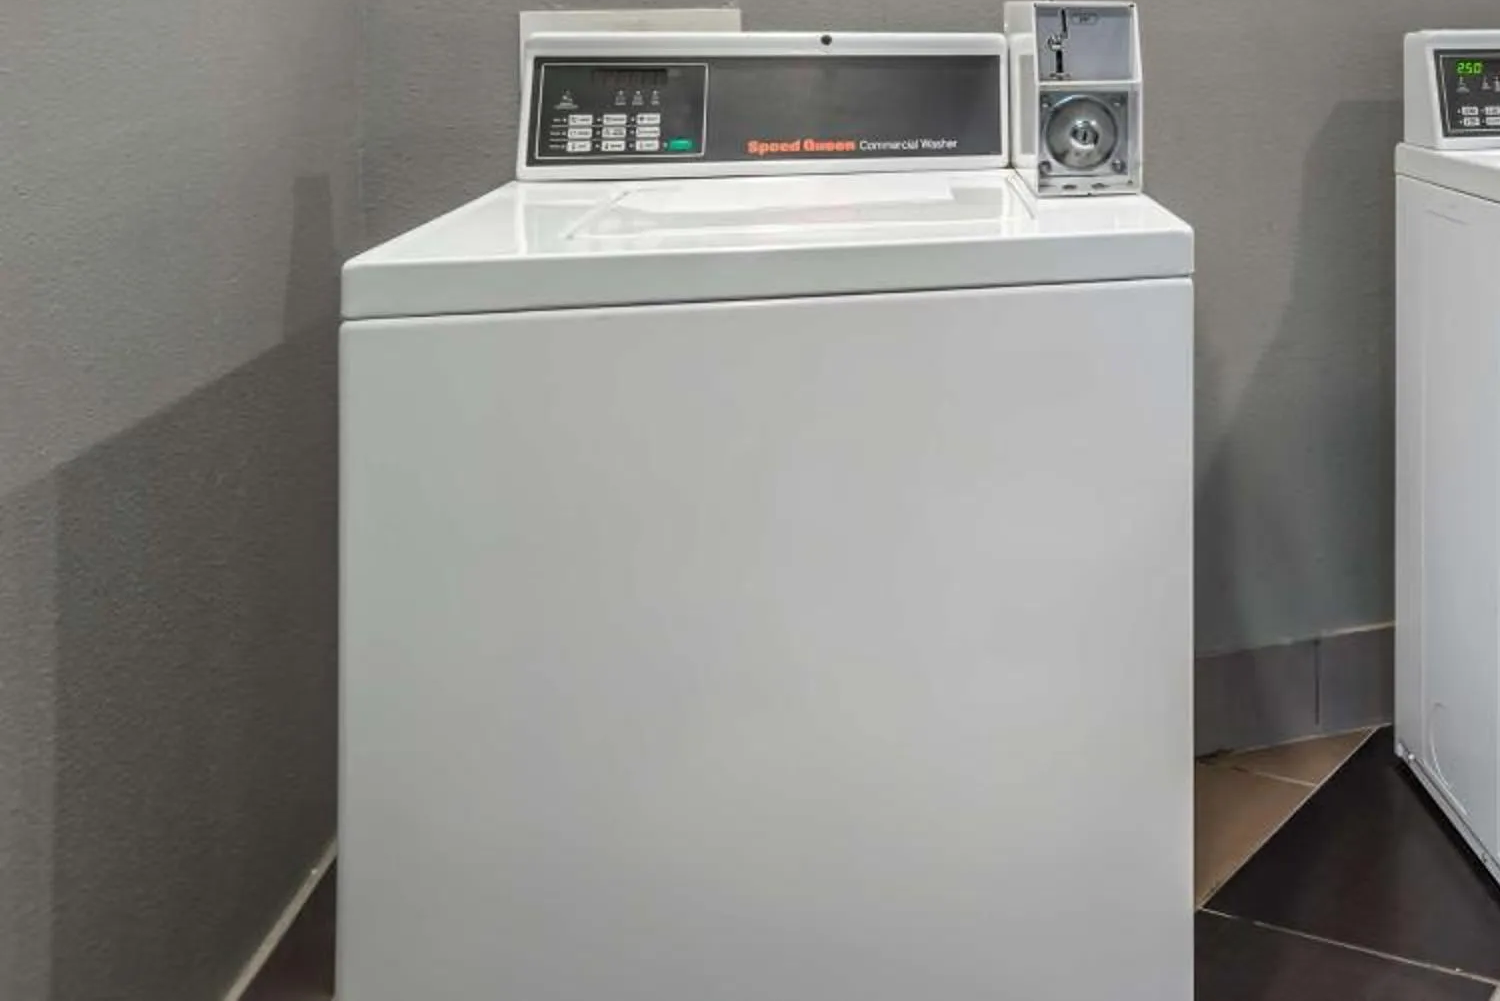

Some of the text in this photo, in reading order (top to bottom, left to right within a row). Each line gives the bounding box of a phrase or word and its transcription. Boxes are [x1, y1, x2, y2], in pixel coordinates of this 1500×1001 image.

[747, 138, 958, 155] Speed Queen Commercial Washer
